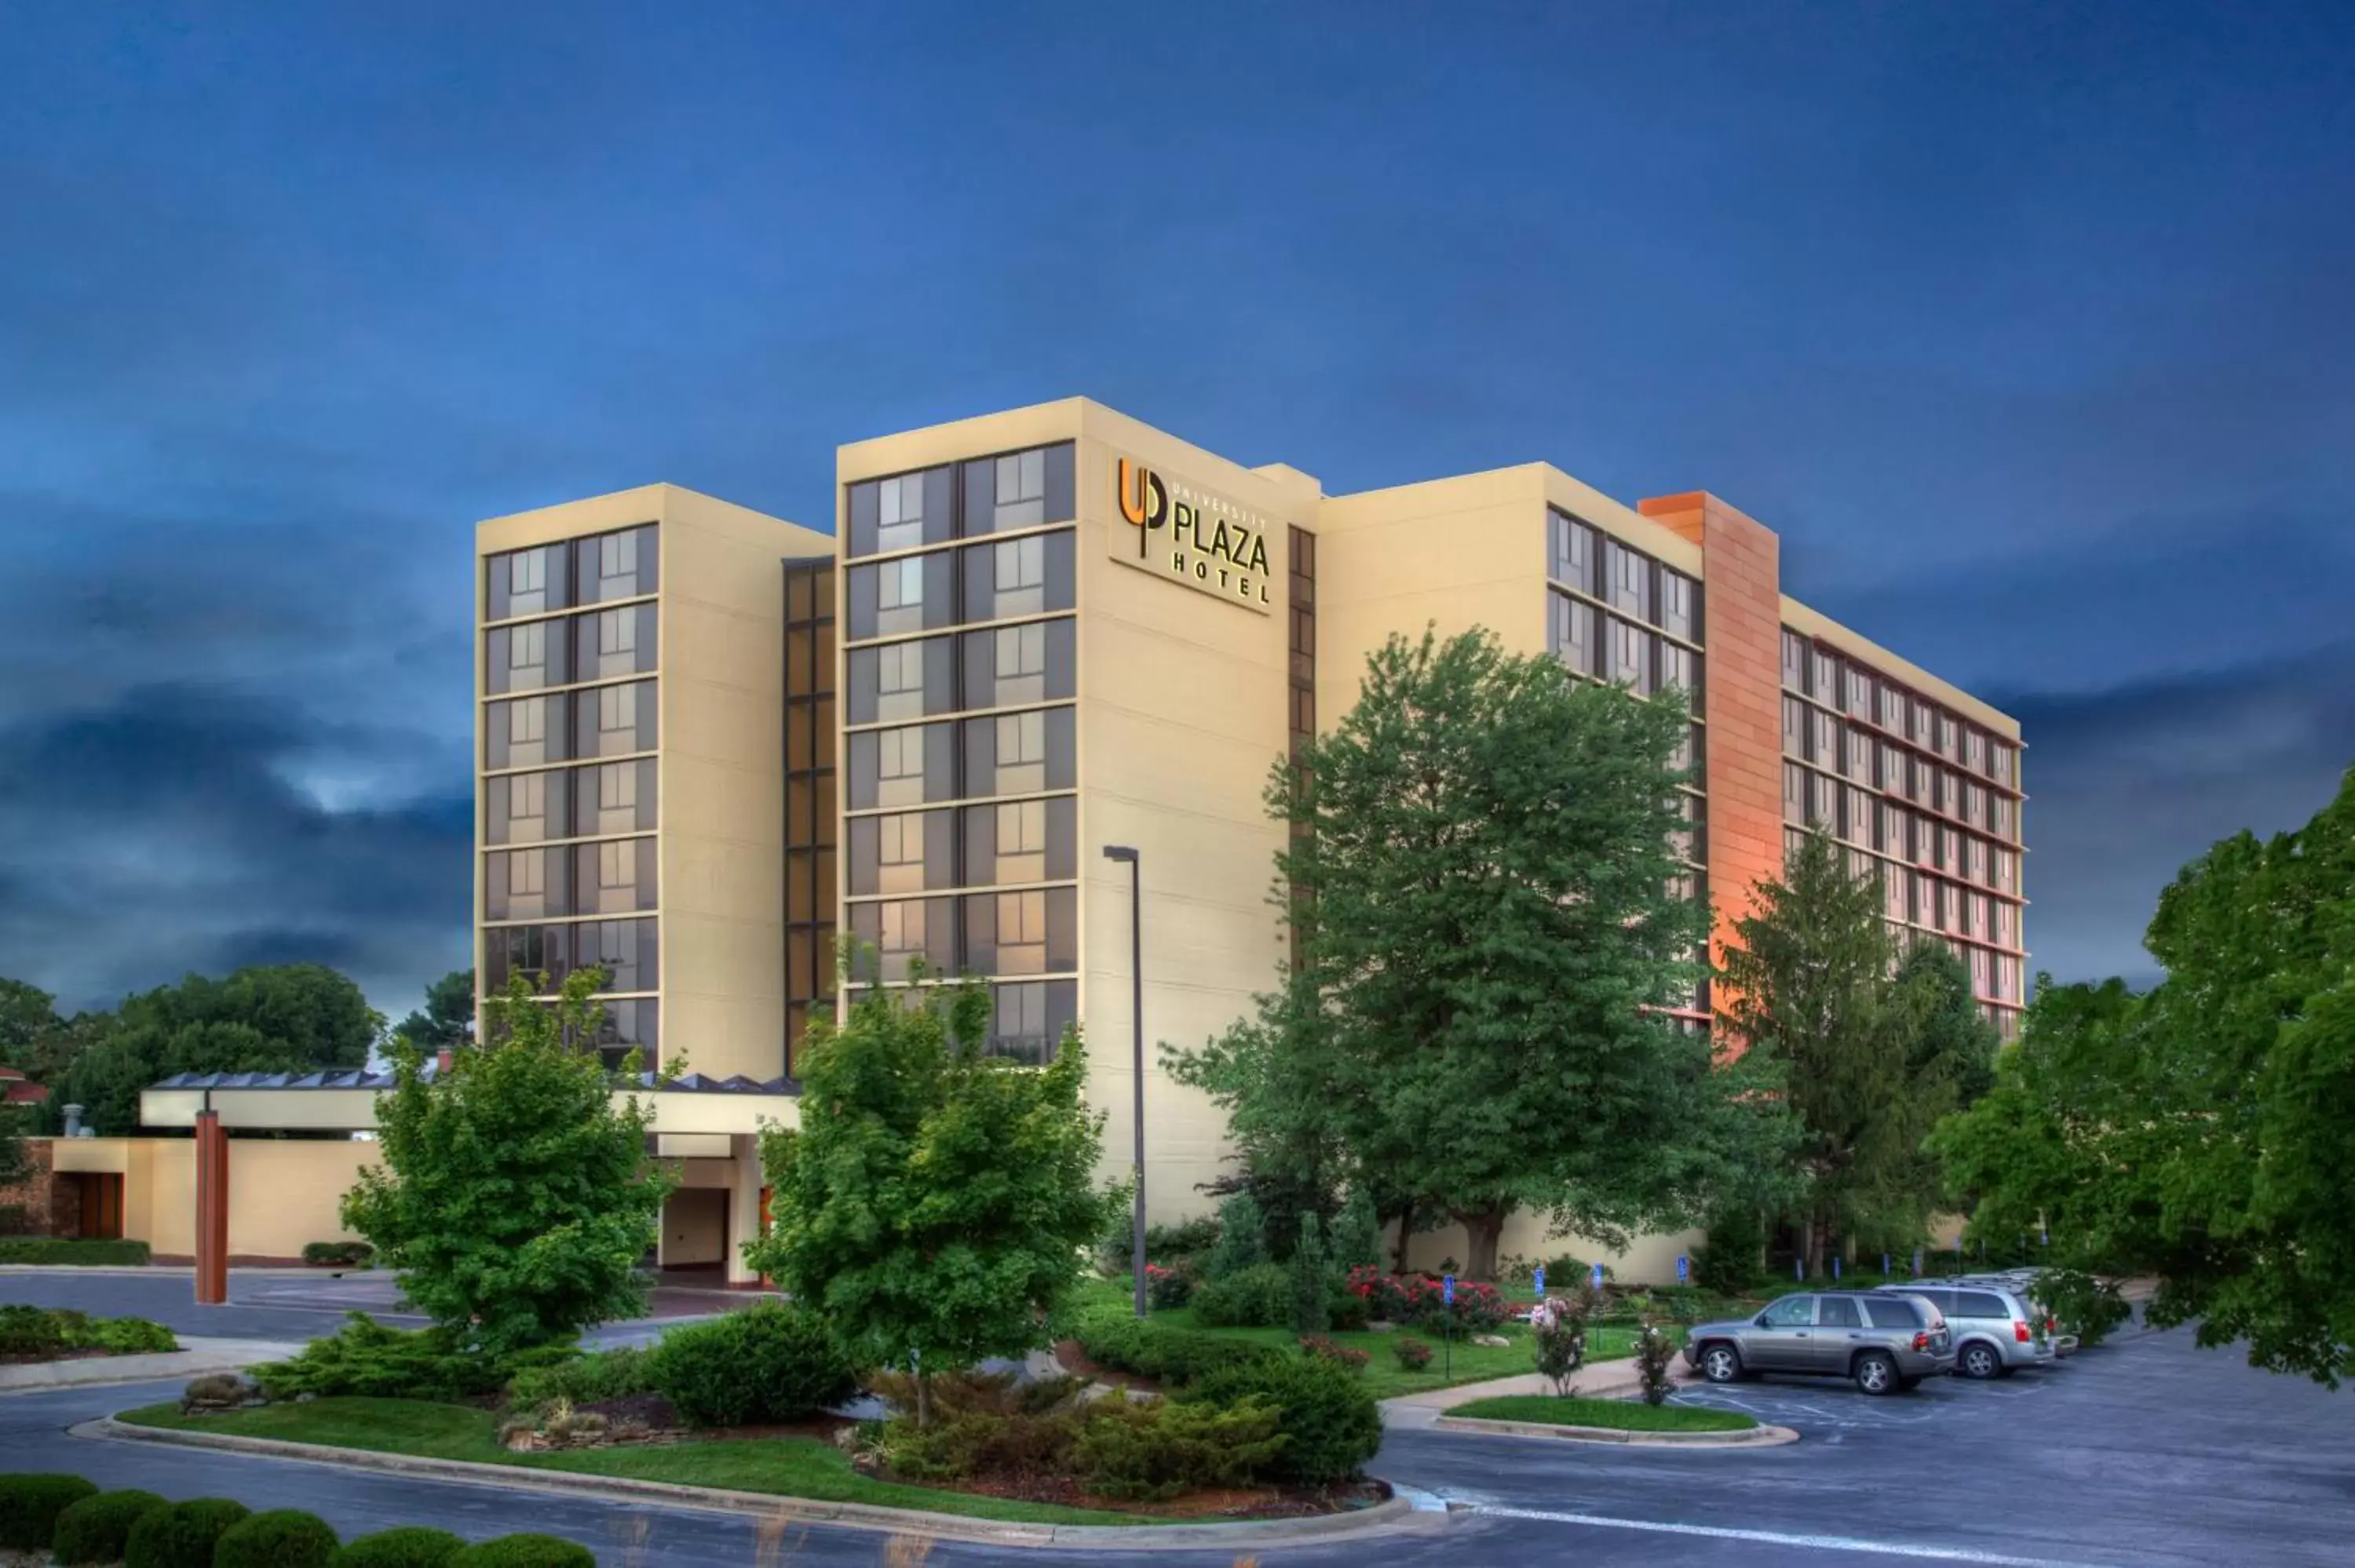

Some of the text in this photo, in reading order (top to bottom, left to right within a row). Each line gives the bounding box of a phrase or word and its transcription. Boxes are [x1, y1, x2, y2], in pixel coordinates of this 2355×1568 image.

[1173, 482, 1266, 529] UNIVERSITY
[1174, 501, 1269, 577] PLAZA
[1174, 552, 1269, 603] HOTEL
